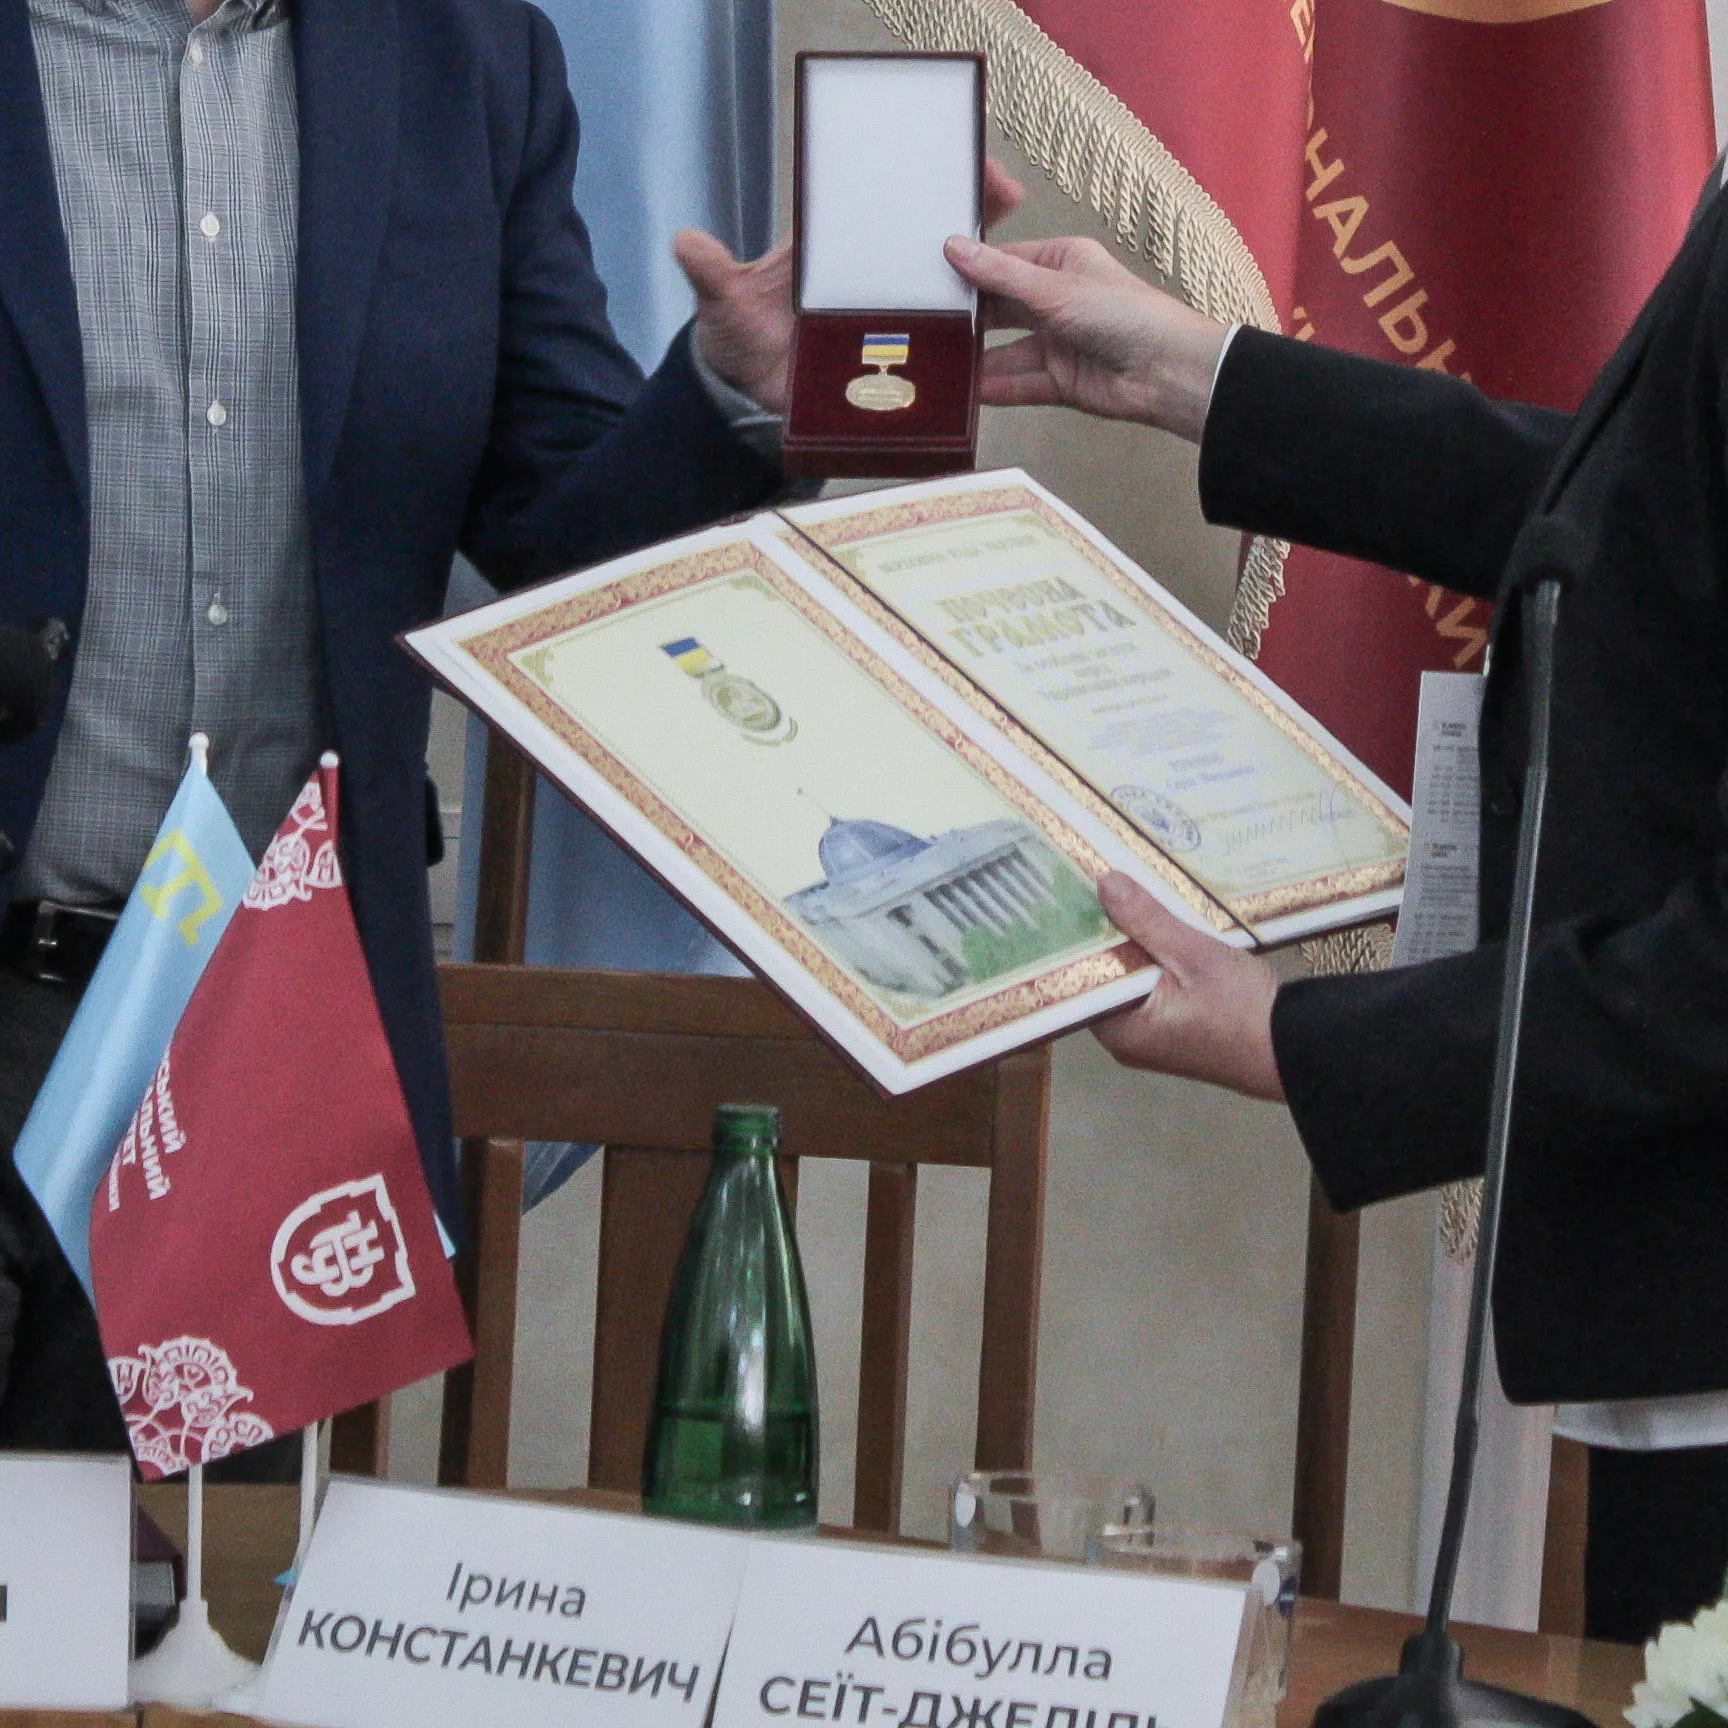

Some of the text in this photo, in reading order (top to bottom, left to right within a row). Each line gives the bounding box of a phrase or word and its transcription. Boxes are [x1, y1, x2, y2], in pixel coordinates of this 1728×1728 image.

[445, 1561, 588, 1619] Ірина
[297, 1609, 701, 1703] КОНСТАНКЕВИЧ
[845, 1616, 1113, 1681] Абібулла
